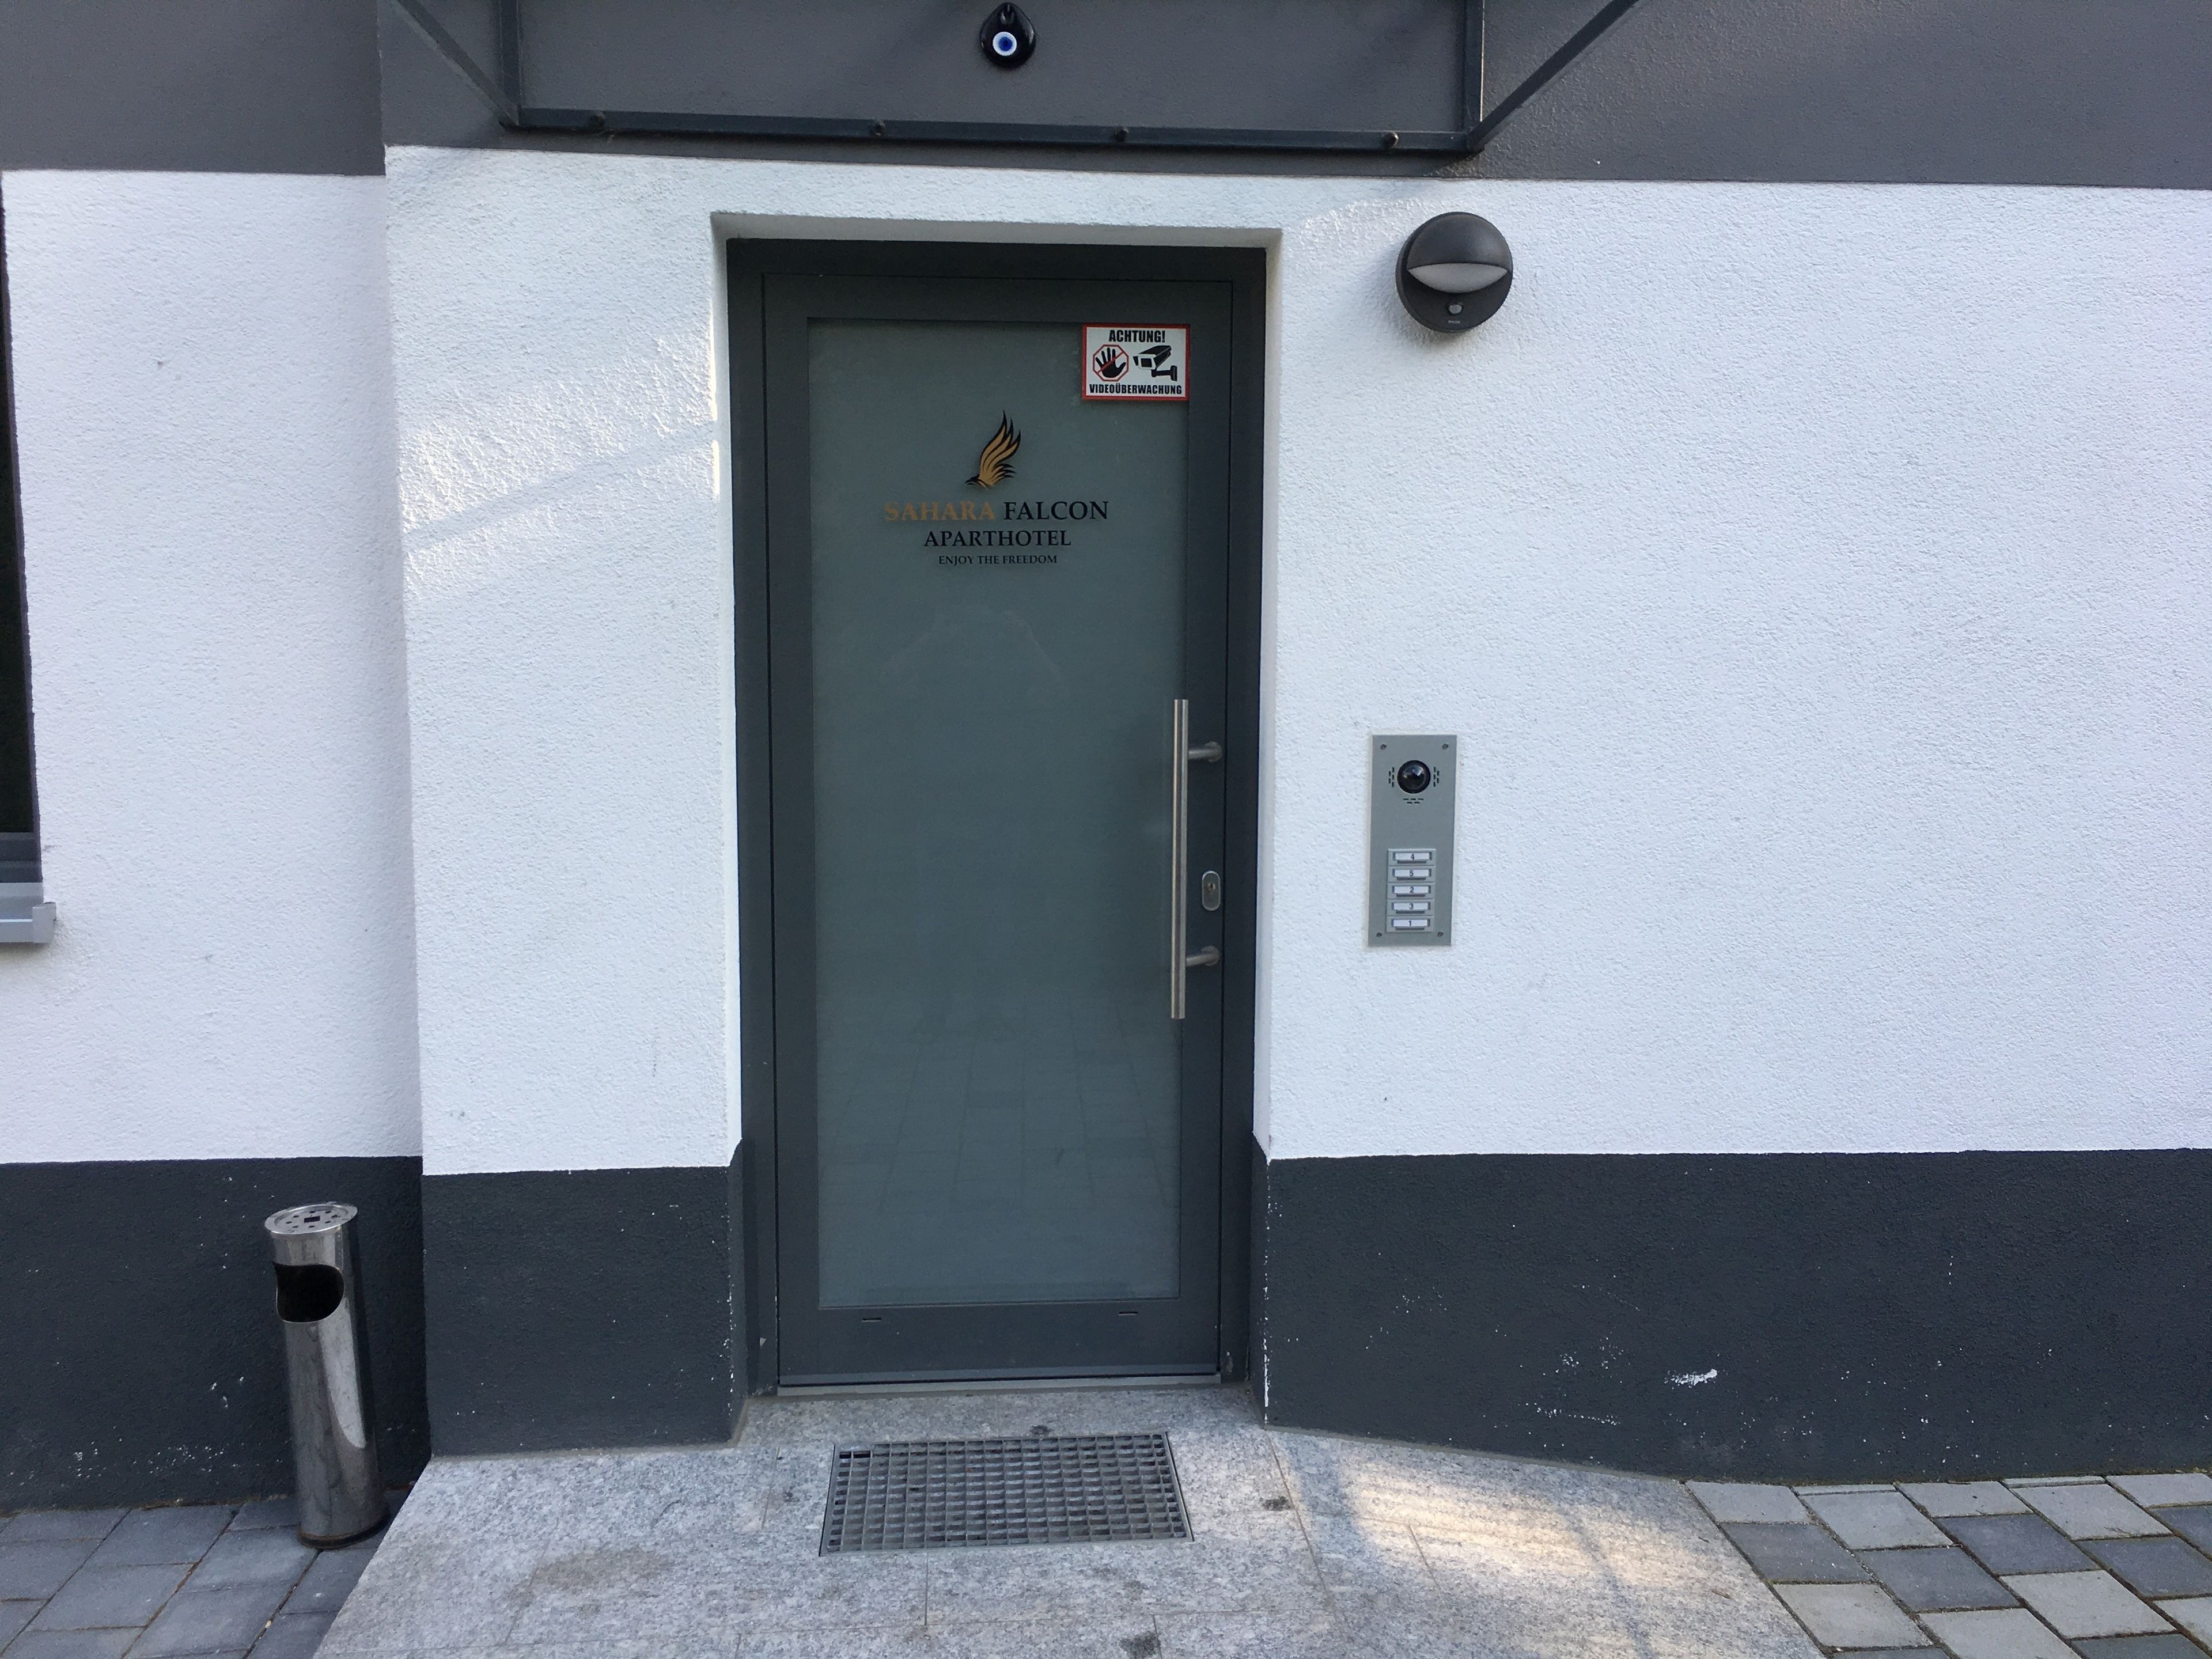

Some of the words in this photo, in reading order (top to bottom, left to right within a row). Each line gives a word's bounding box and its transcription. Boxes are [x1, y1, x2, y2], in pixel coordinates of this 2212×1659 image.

[1108, 329, 1165, 343] ACHTUNG!
[1089, 382, 1182, 395] VIDEOÜBERWACHUNG
[884, 501, 996, 521] SAHARA
[1003, 501, 1109, 520] FALCON
[924, 531, 1071, 547] APARTHOTEL
[938, 555, 974, 566] ENJOY
[977, 555, 999, 565] THE
[1002, 555, 1058, 564] FREEDOM
[1410, 853, 1415, 861] 4
